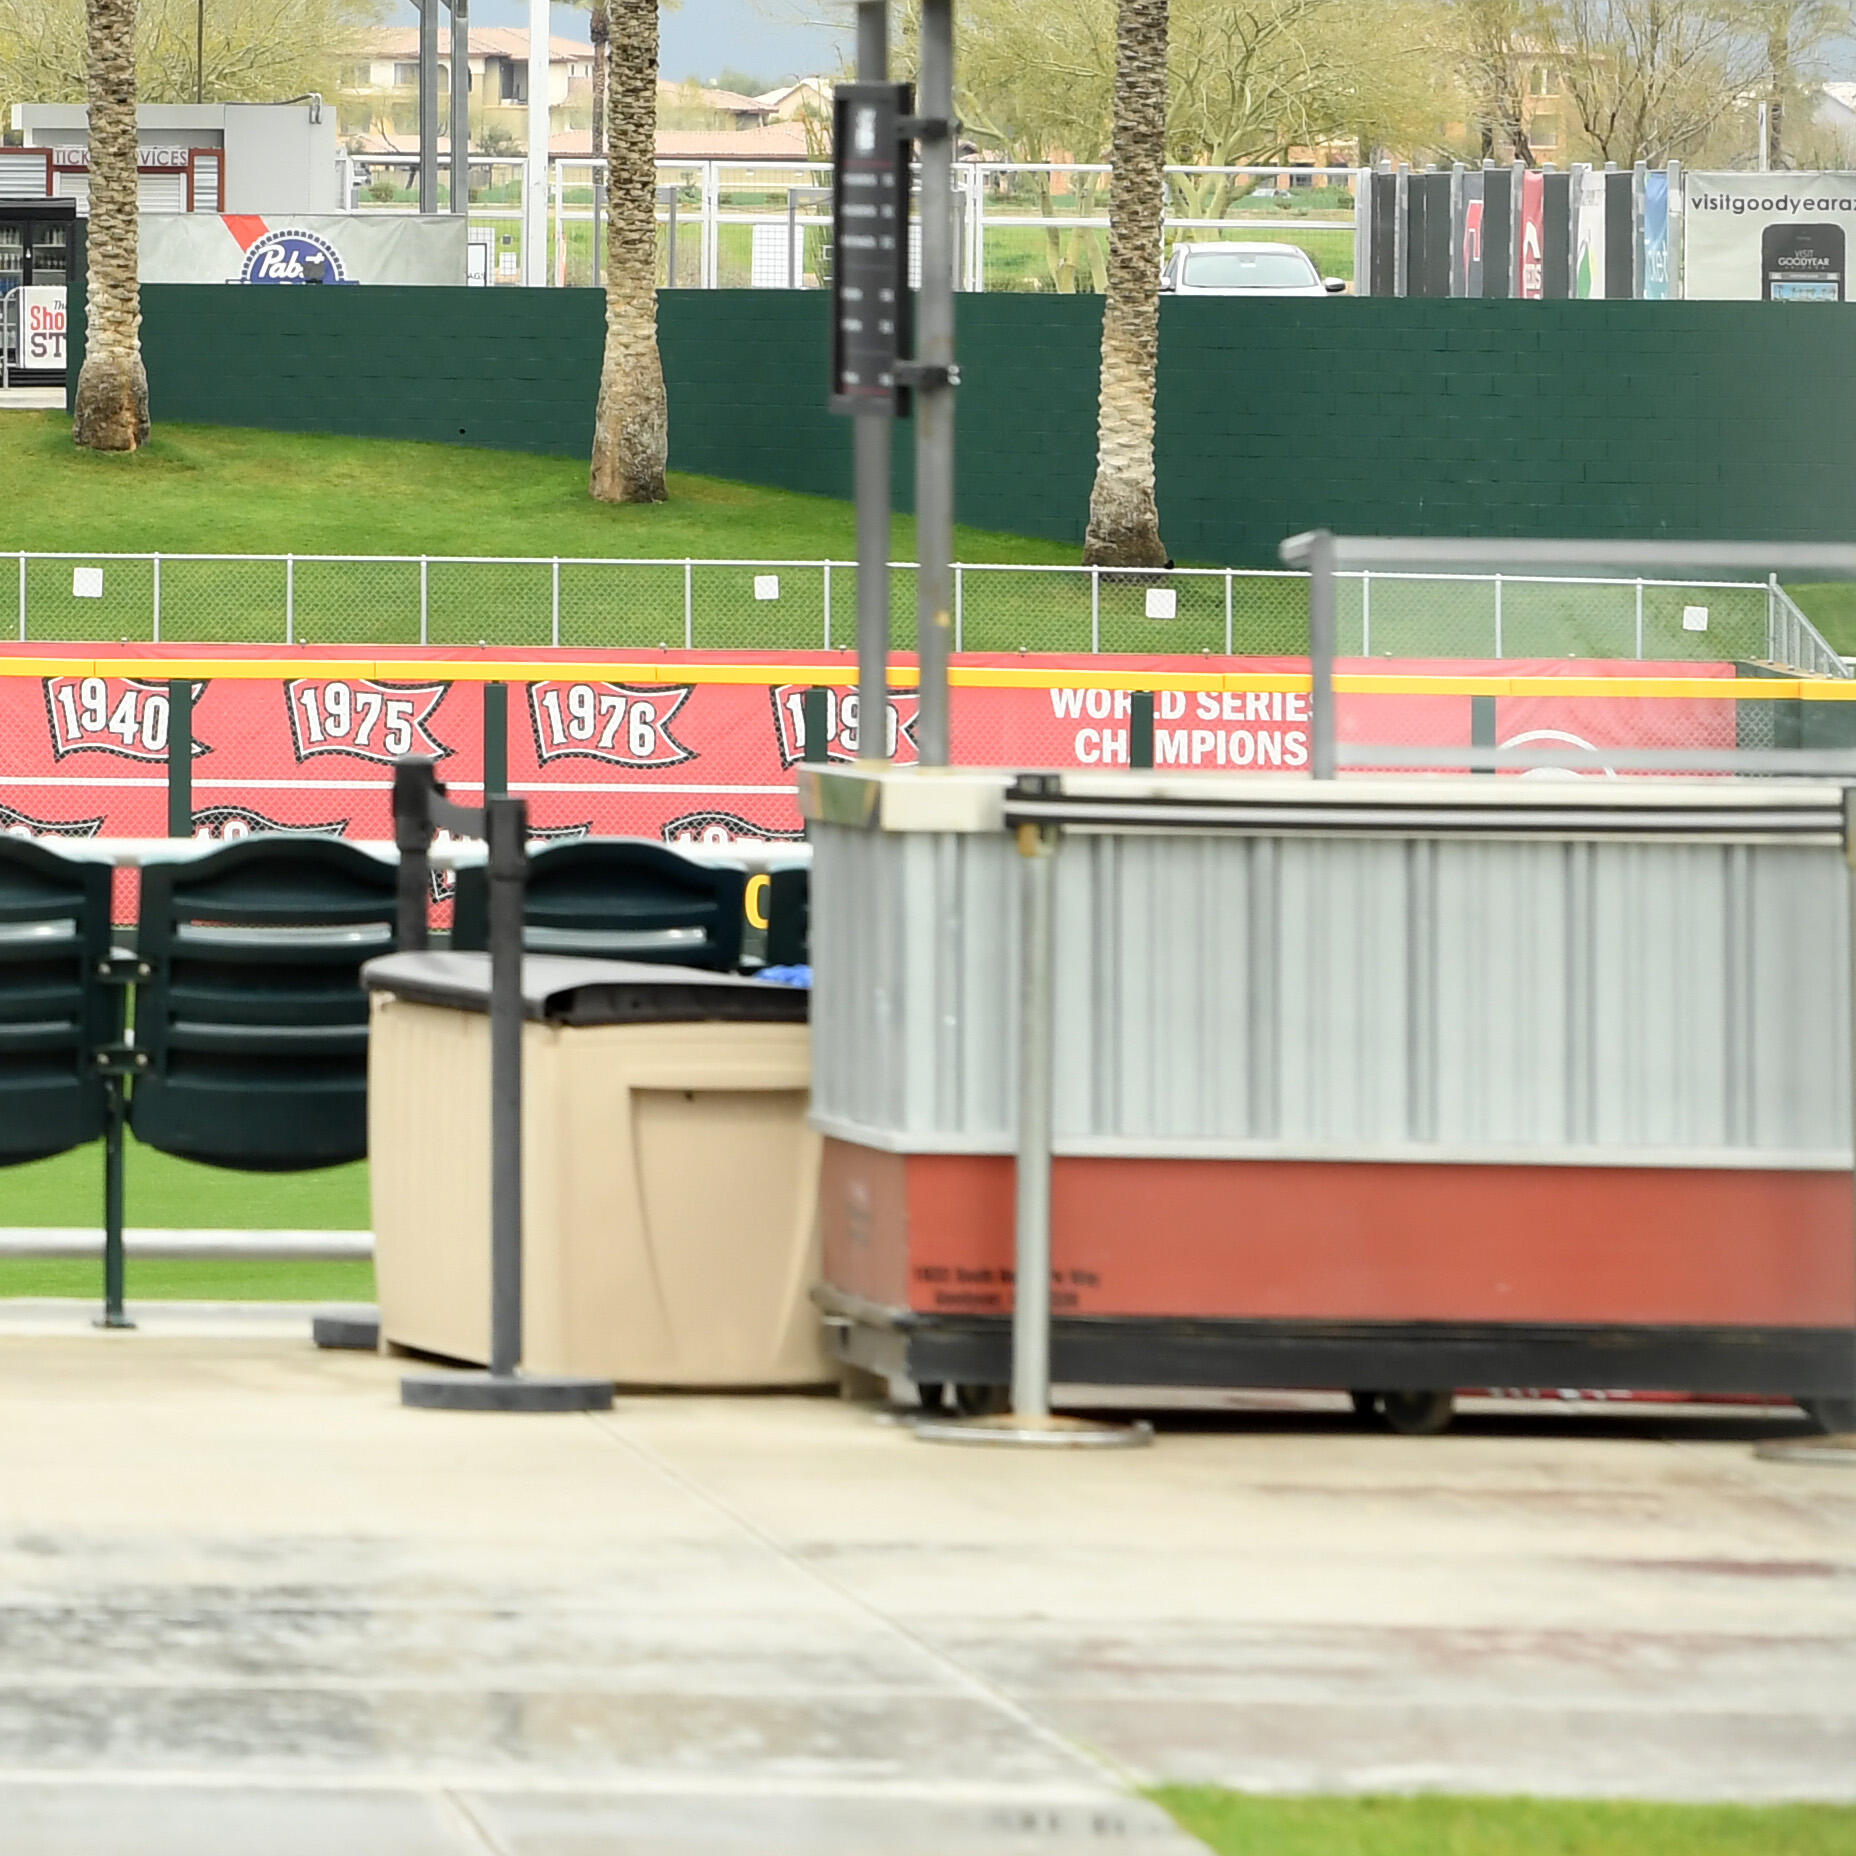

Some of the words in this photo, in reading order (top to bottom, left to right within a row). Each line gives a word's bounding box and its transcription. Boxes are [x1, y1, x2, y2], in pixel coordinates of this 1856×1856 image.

[55, 150, 89, 165] TICK
[140, 150, 187, 166] VICES
[1691, 194, 1856, 215] visitgoodyeara
[56, 677, 170, 752] 1940
[299, 681, 415, 755] 1975
[541, 683, 658, 758] 1976
[1049, 687, 1187, 720] WORD
[1196, 691, 1314, 722] SERIE
[1074, 727, 1309, 766] CHMPIONS
